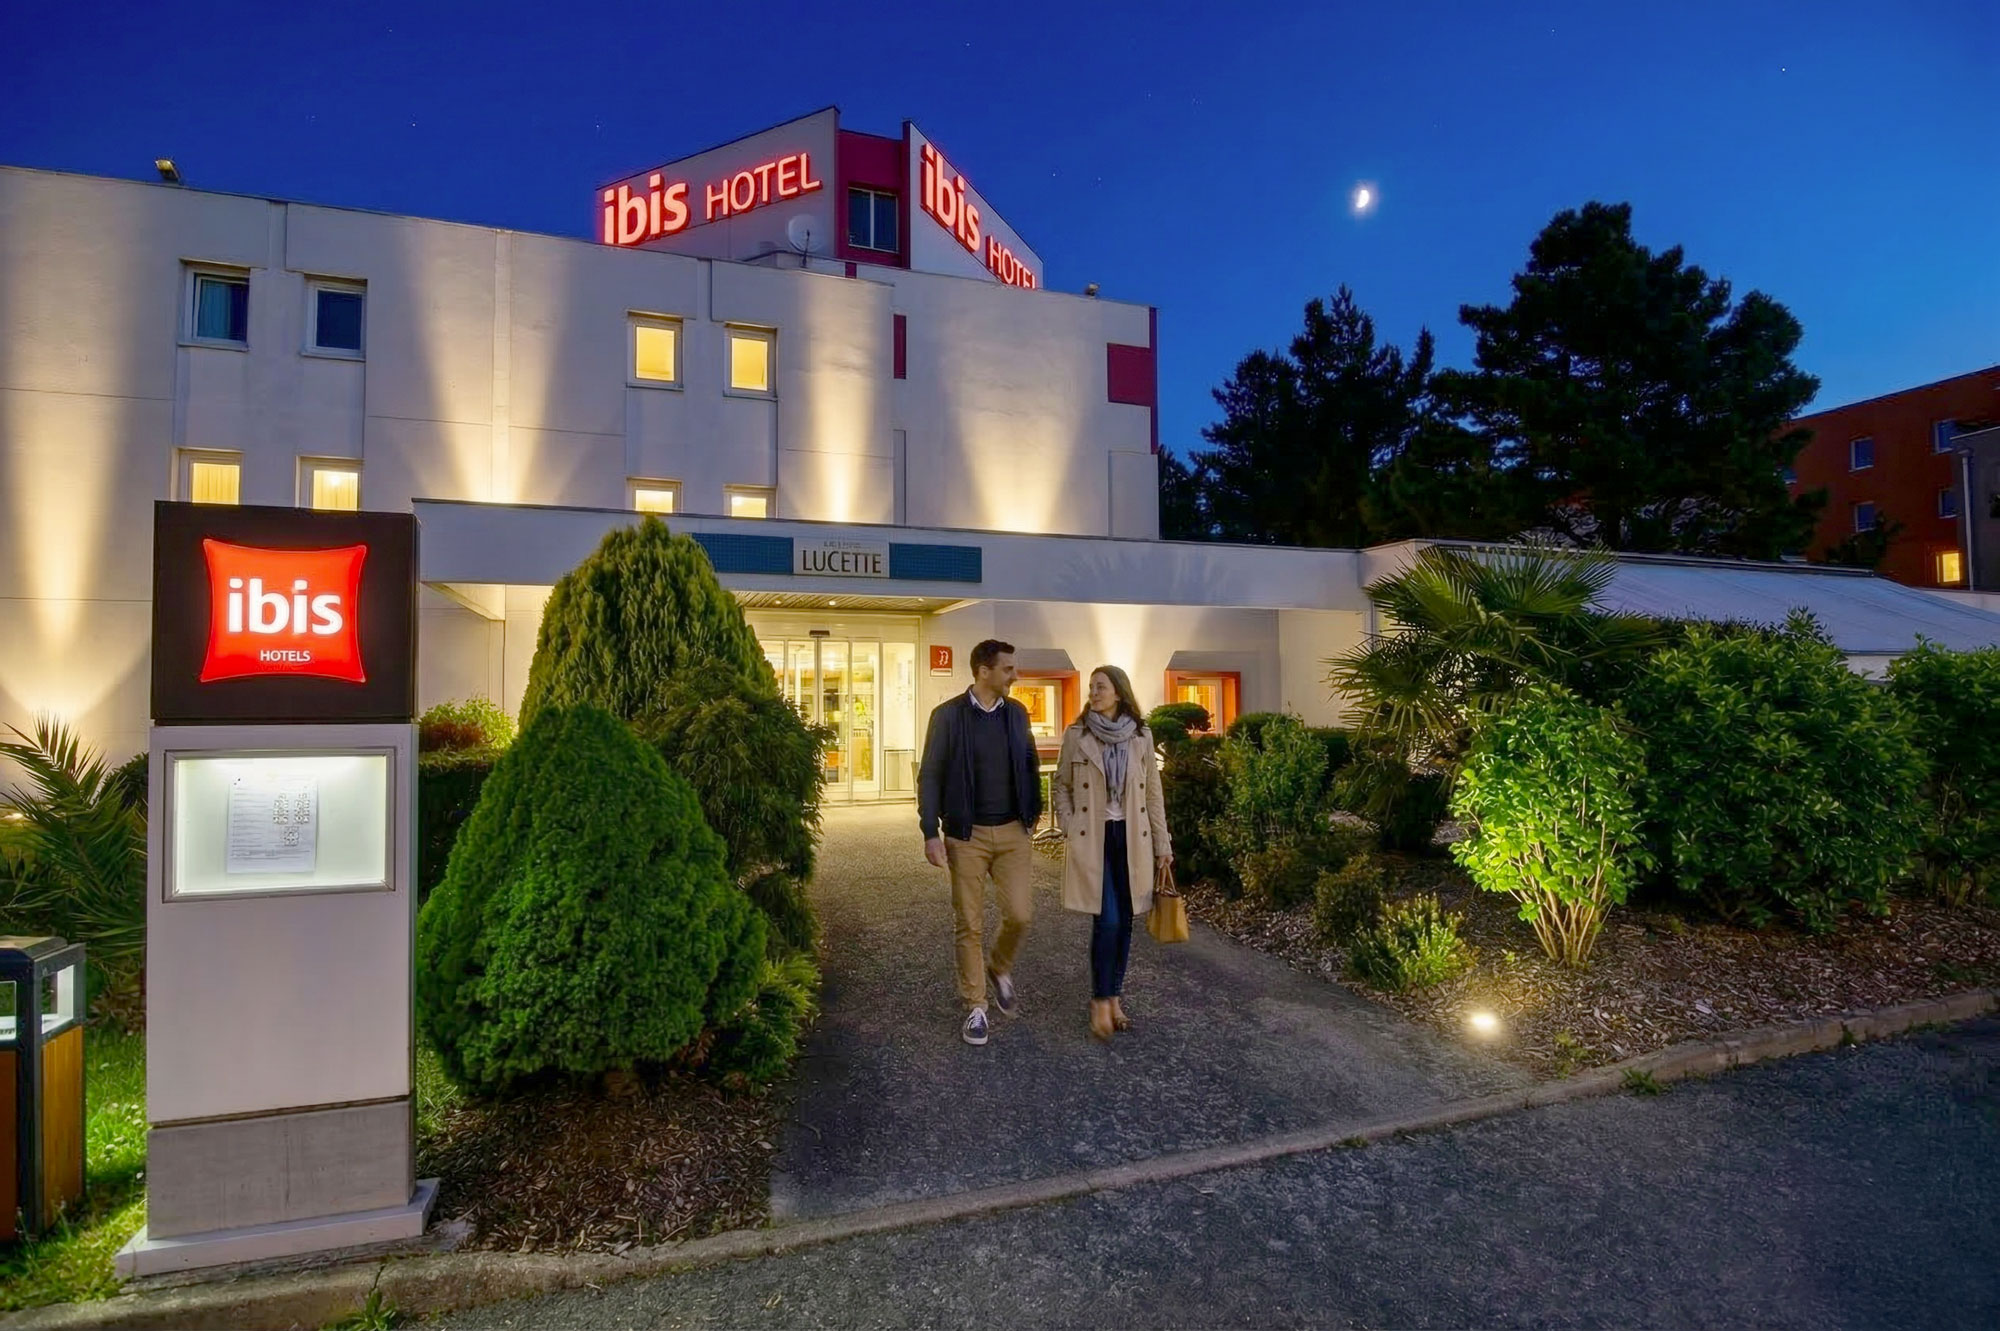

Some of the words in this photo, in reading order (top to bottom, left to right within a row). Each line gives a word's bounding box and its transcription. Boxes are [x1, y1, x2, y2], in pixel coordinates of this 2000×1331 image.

[603, 173, 688, 246] ibis
[705, 153, 821, 220] HOTEL
[921, 143, 981, 252] ibis
[802, 549, 882, 573] LUCETTE
[228, 577, 343, 635] ibis
[259, 650, 311, 662] HOTELS
